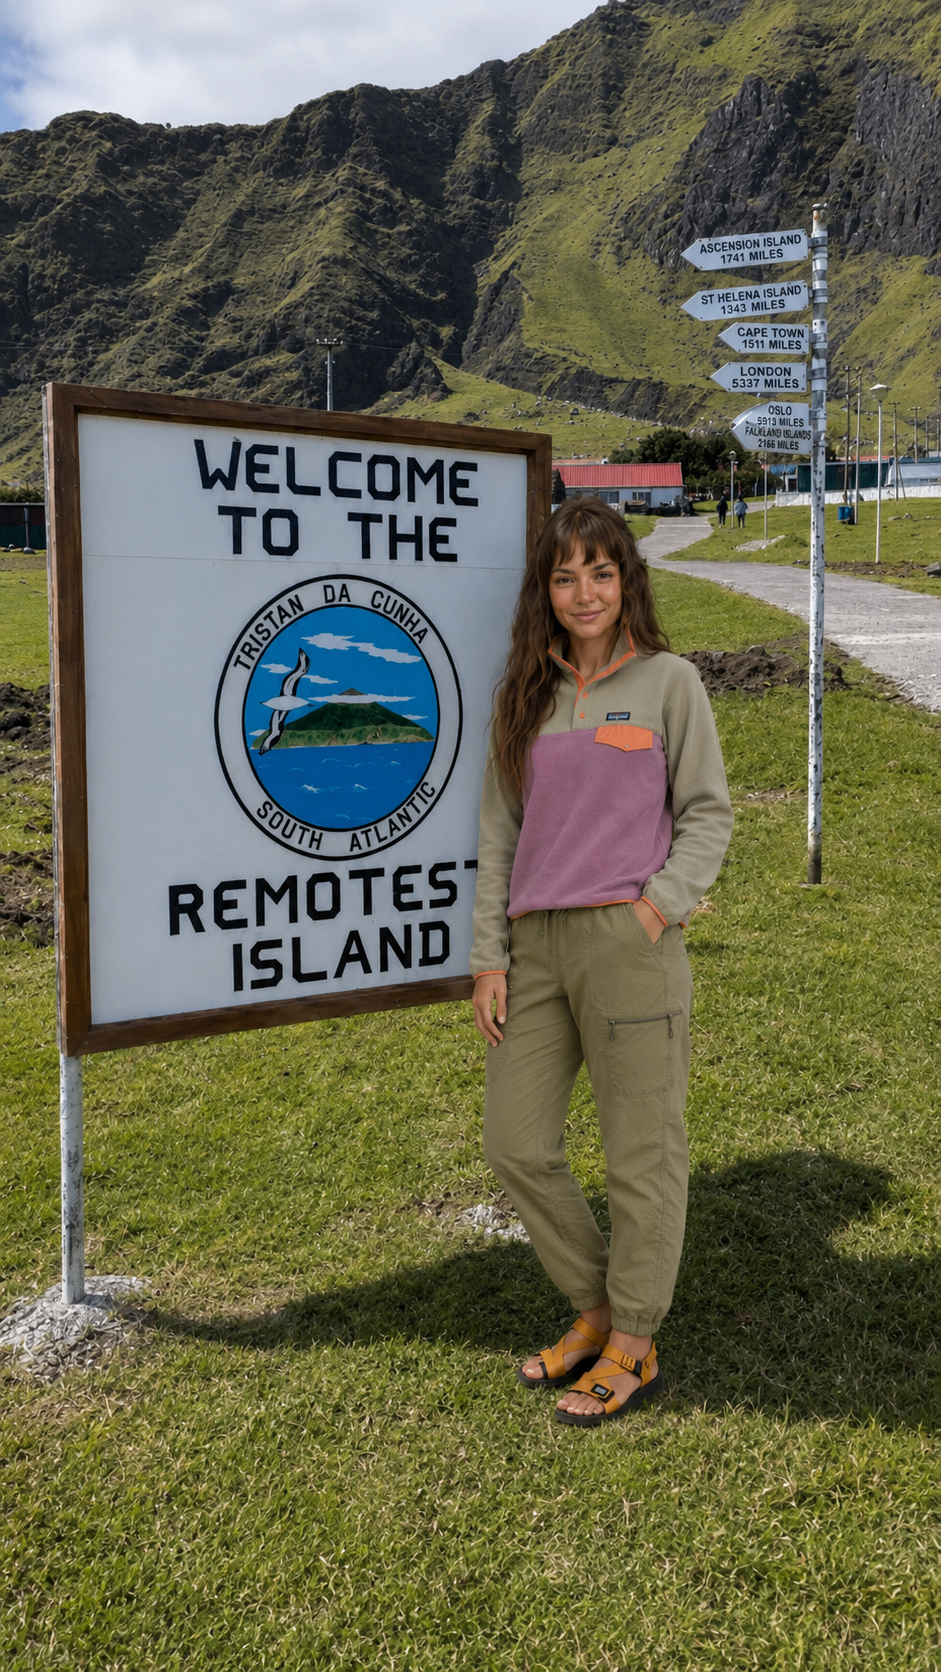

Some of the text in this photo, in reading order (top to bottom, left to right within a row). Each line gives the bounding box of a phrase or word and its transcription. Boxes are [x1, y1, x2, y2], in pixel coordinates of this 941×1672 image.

[700, 234, 801, 254] ASCENSION ISLAND
[720, 248, 784, 264] 1741 MILES
[701, 285, 801, 305] ST HELENA ISLAND
[720, 299, 786, 315] 1343 MILES
[737, 327, 804, 338] CAPE TOWN
[742, 339, 802, 350] 1511 MILES
[740, 366, 792, 377] LONDON
[732, 378, 799, 389] 5337 MILES
[768, 405, 792, 416] OSLO
[779, 418, 804, 427] MILES
[777, 440, 799, 450] MILES
[193, 438, 479, 507] WELCOME
[217, 505, 458, 562] TO THE
[233, 583, 429, 671] TRISTAN DA CUNHA
[256, 781, 436, 852] SOUTH ATLANTIC
[233, 920, 450, 992] ISLAND
